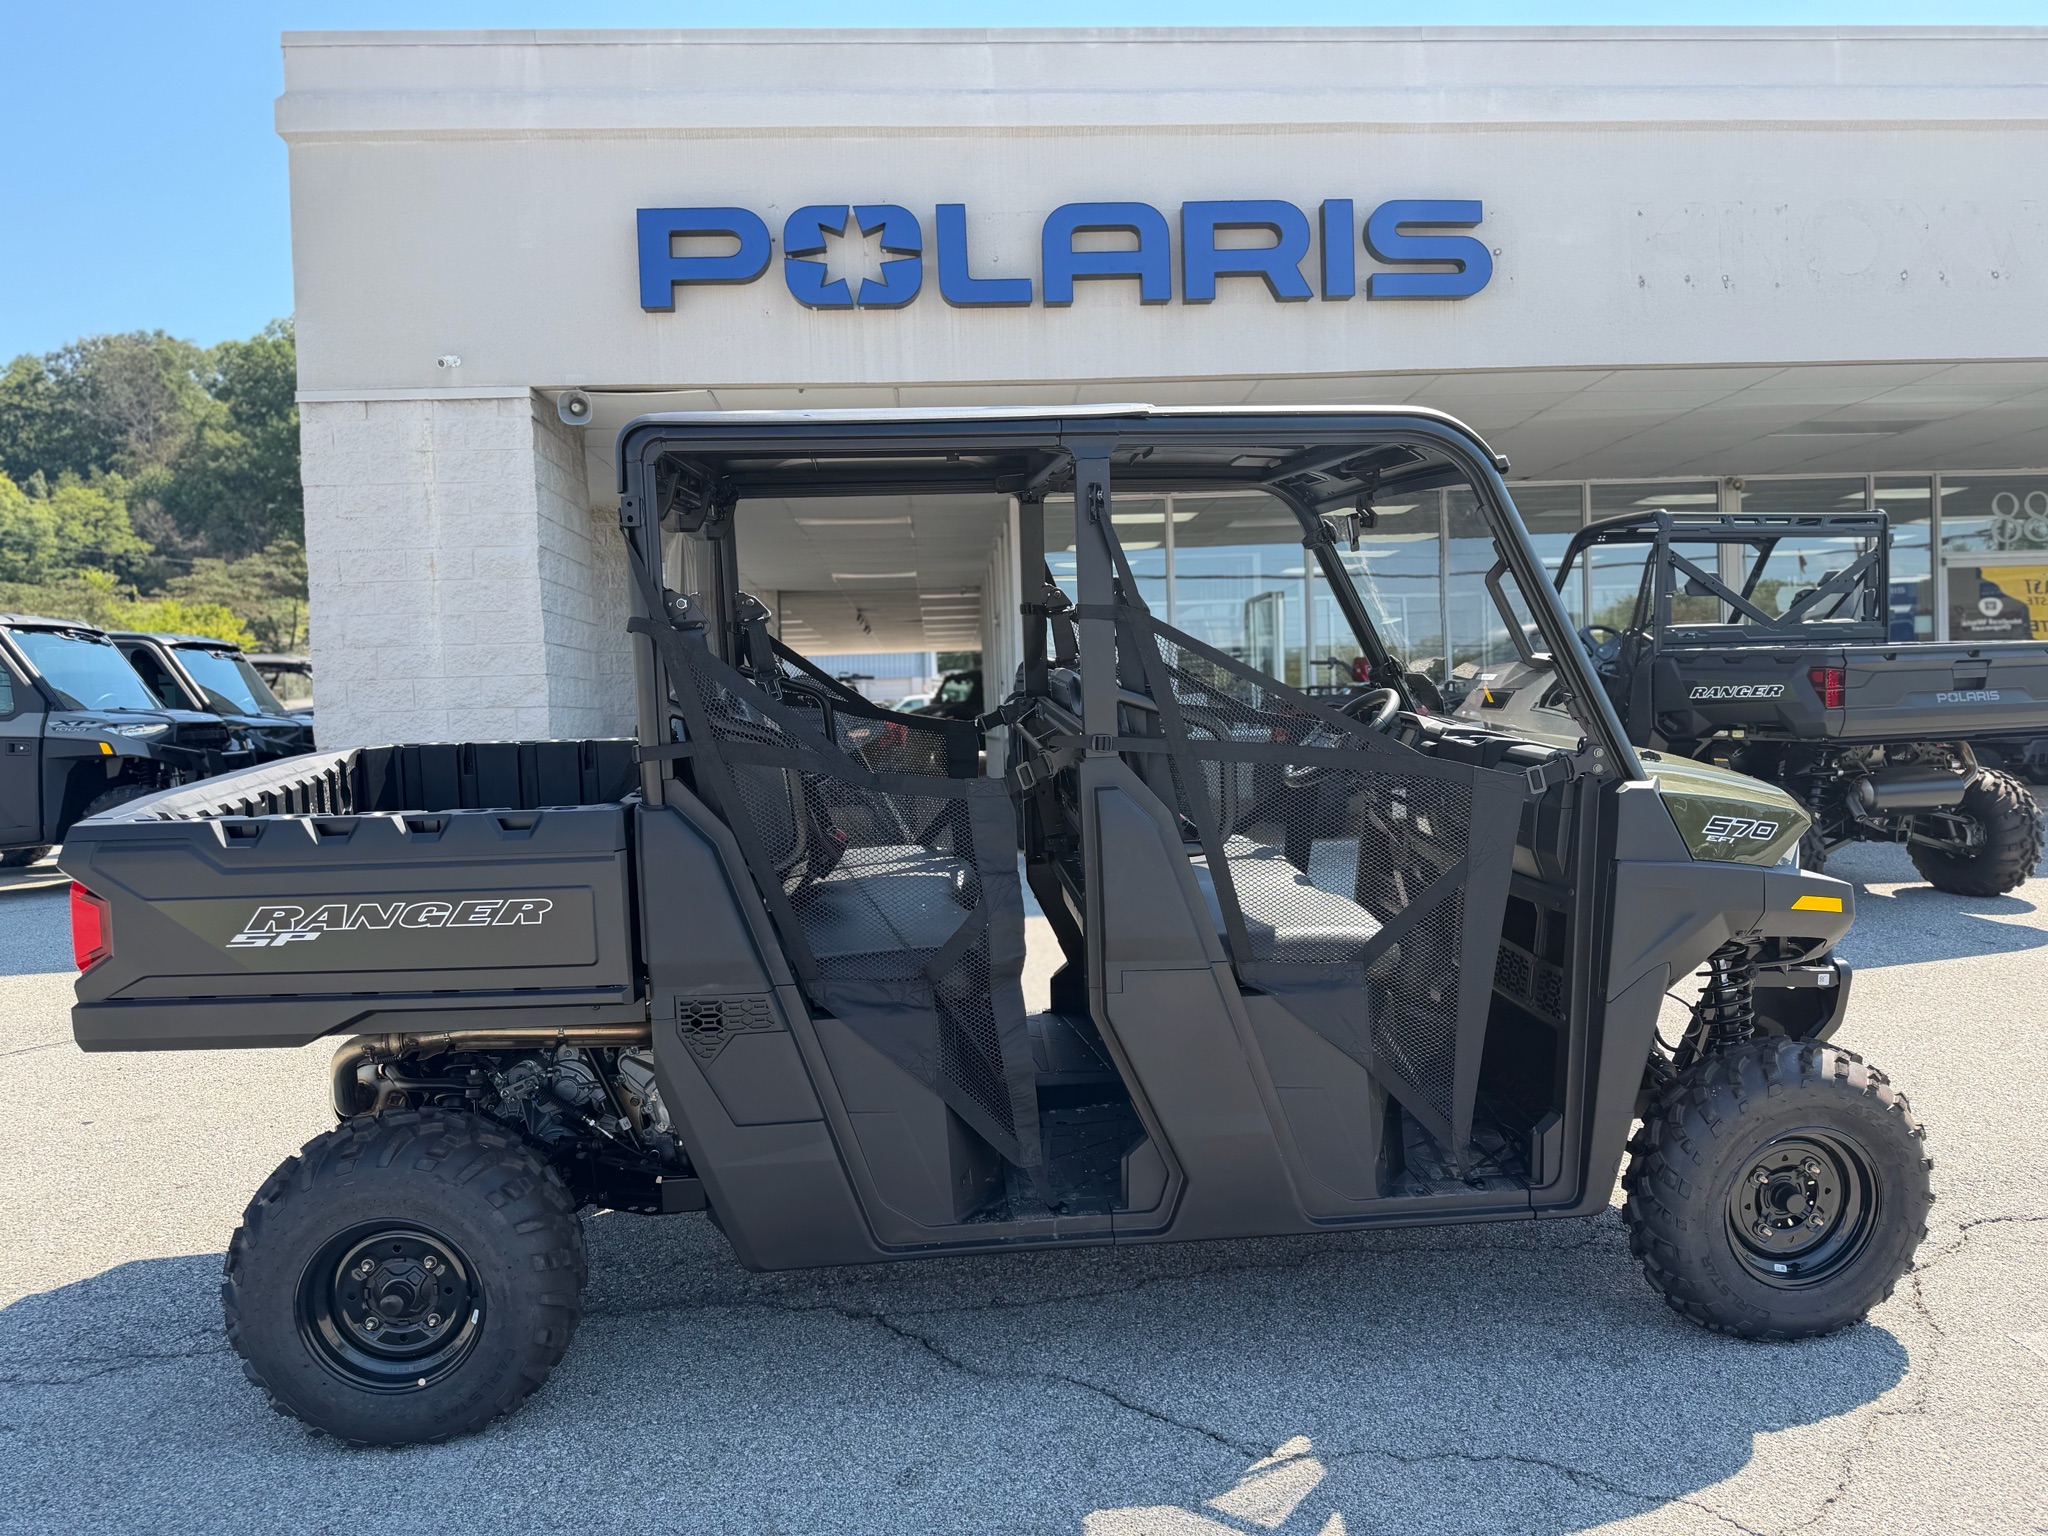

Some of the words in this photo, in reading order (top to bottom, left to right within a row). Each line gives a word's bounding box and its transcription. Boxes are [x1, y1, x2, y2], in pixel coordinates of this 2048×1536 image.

[637, 198, 1493, 312] POLARIS
[1690, 684, 1785, 699] RANGER
[1936, 690, 2000, 704] POLARIS
[54, 719, 97, 727] XP
[1702, 815, 1778, 841] 570
[1706, 835, 1735, 844] EFI
[244, 898, 553, 933] RANGER
[226, 931, 322, 948] SP
